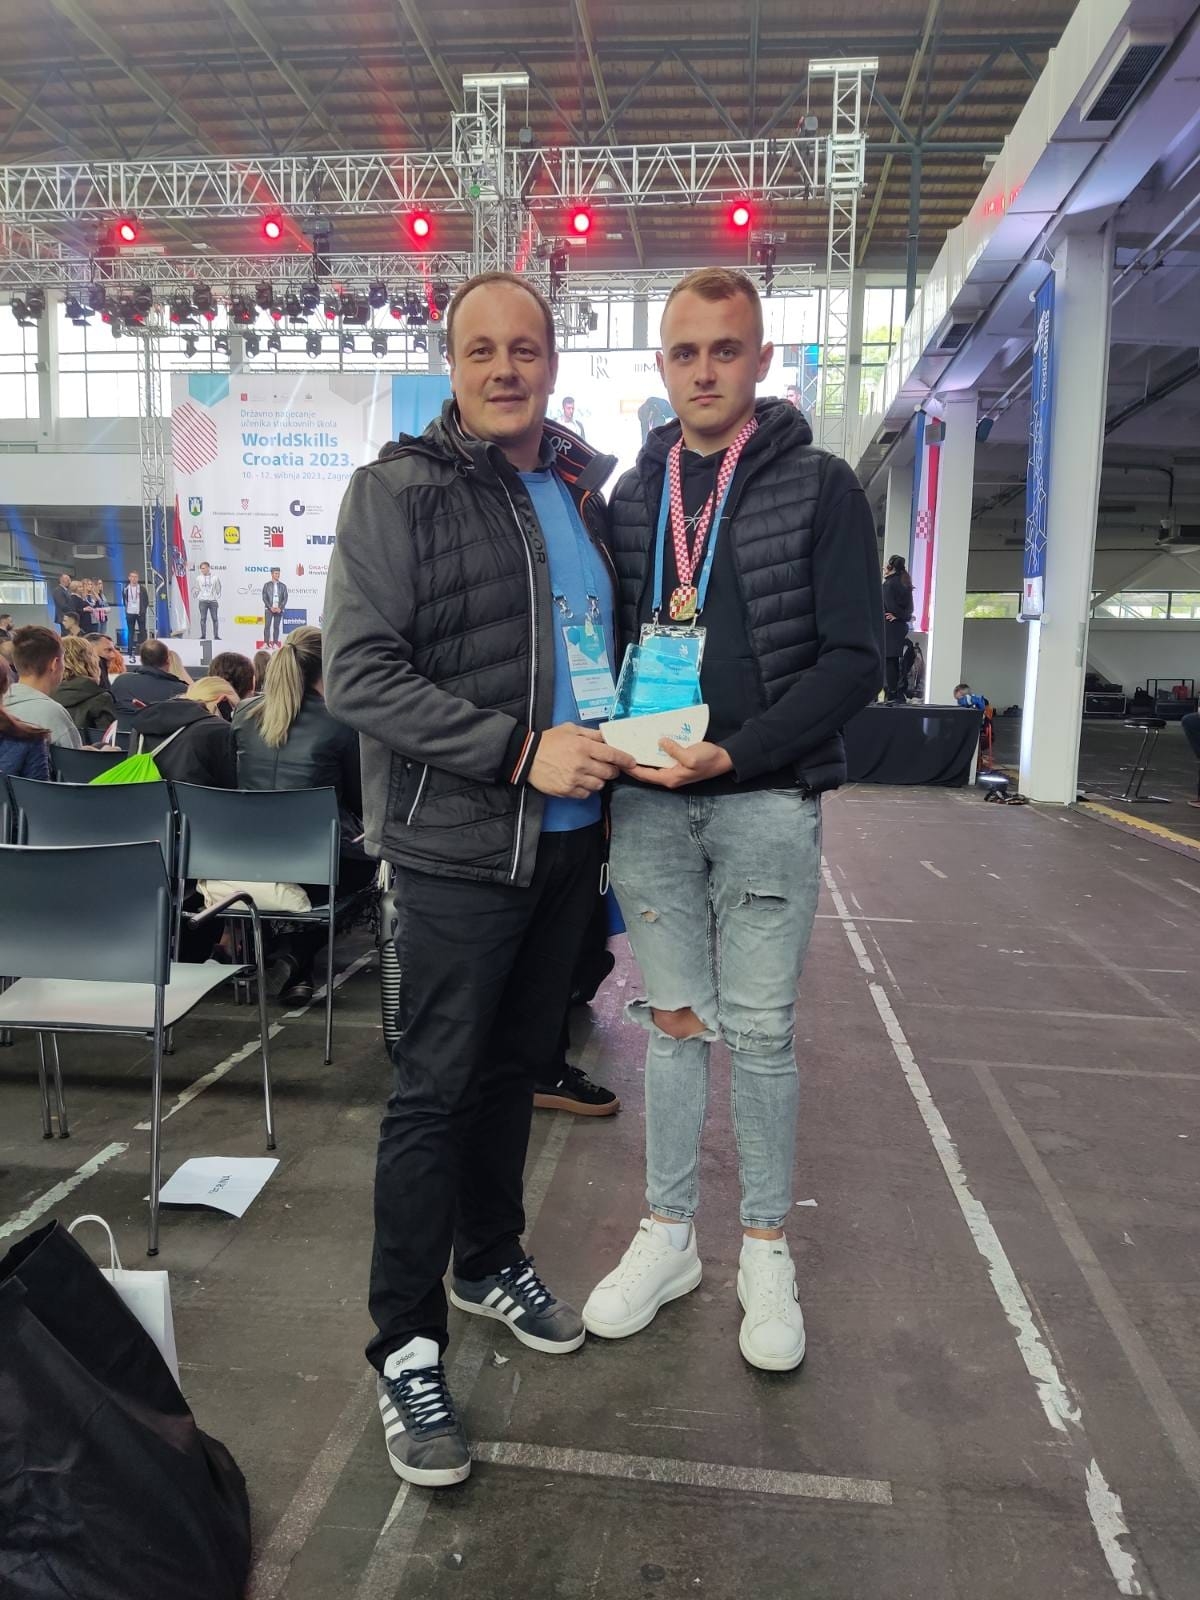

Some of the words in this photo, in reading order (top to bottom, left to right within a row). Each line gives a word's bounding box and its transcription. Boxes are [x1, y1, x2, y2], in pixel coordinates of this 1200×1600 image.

[241, 432, 338, 447] WorldSkills
[242, 452, 304, 467] Croatia
[309, 453, 354, 467] 2023.
